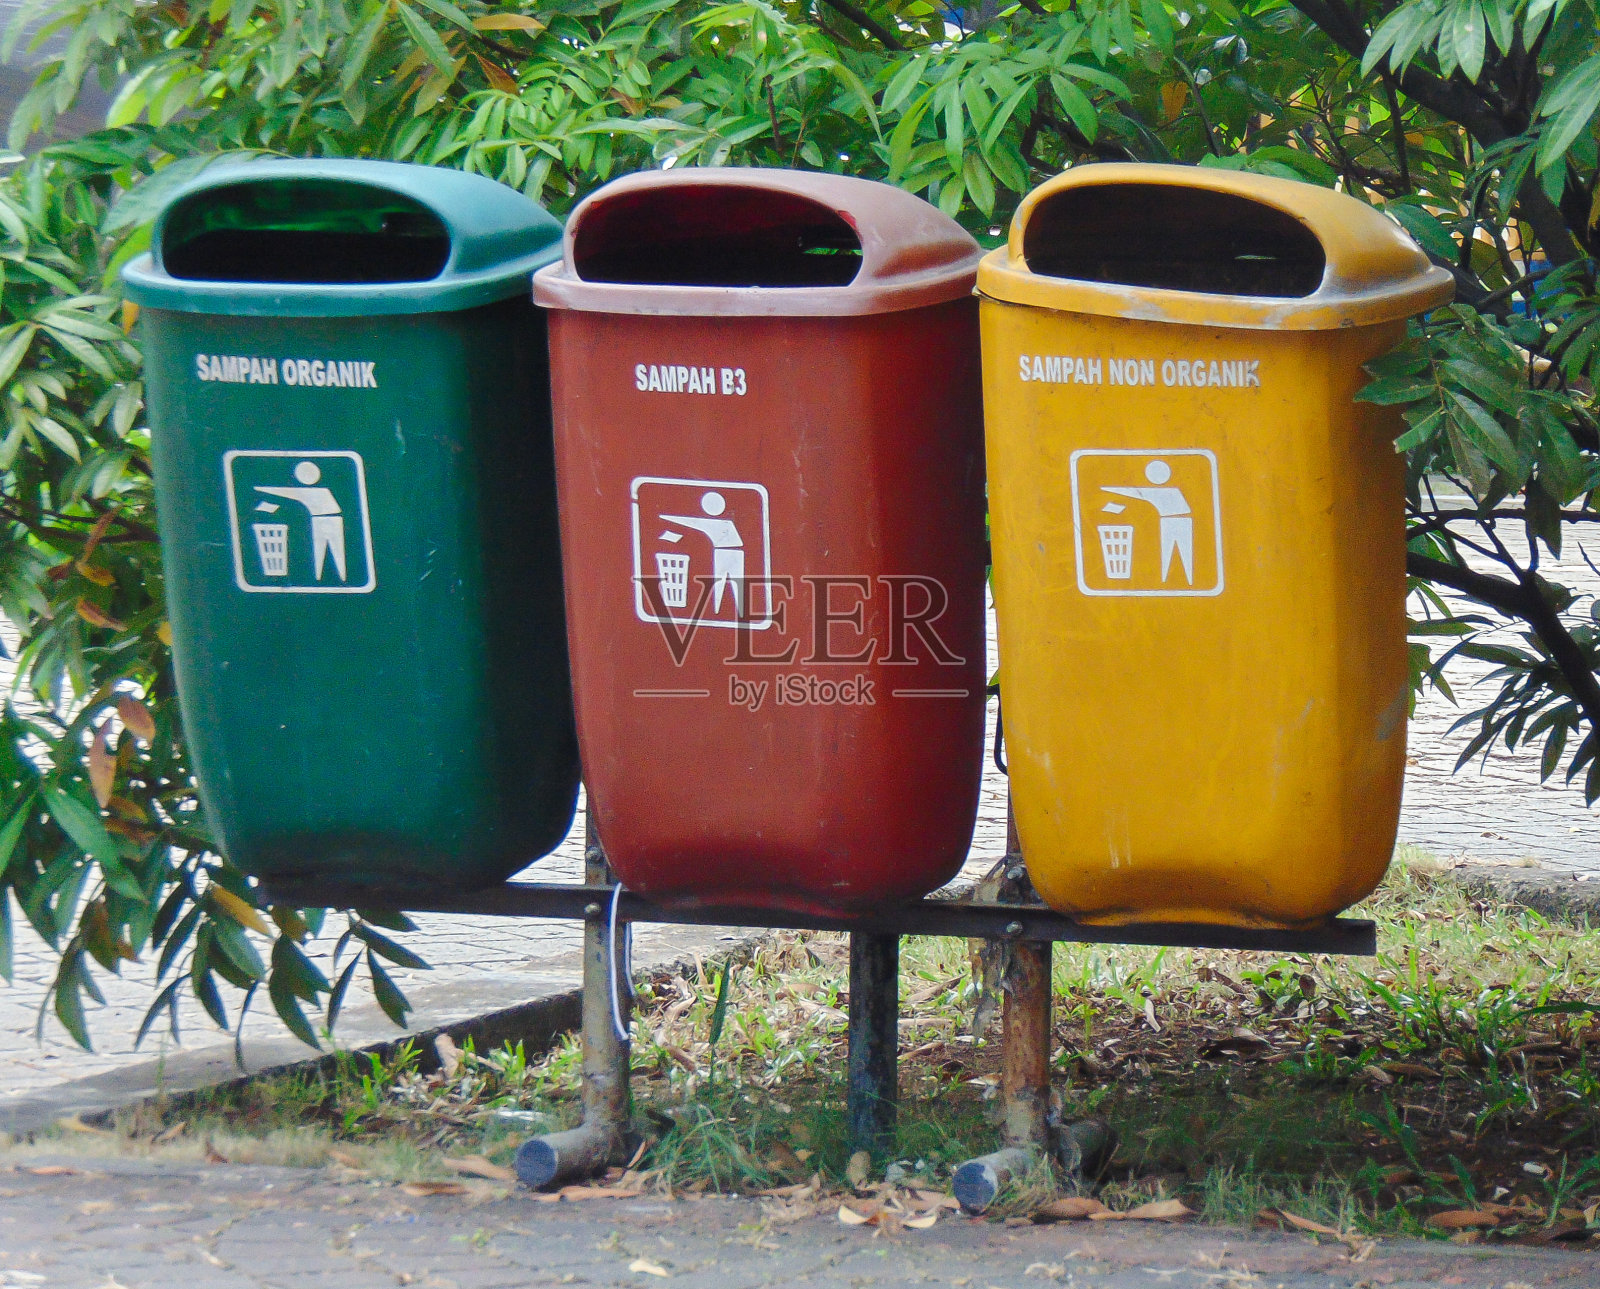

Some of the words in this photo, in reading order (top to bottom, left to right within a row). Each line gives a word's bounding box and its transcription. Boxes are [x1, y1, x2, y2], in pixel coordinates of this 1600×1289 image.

[196, 354, 278, 384] SAMPAH
[282, 359, 378, 388] ORGANIK
[635, 363, 716, 394] SAMPAH
[721, 368, 747, 396] B3
[1019, 355, 1102, 384] SAMPAH
[1109, 359, 1155, 386] NON
[1162, 359, 1260, 387] ORGANIK
